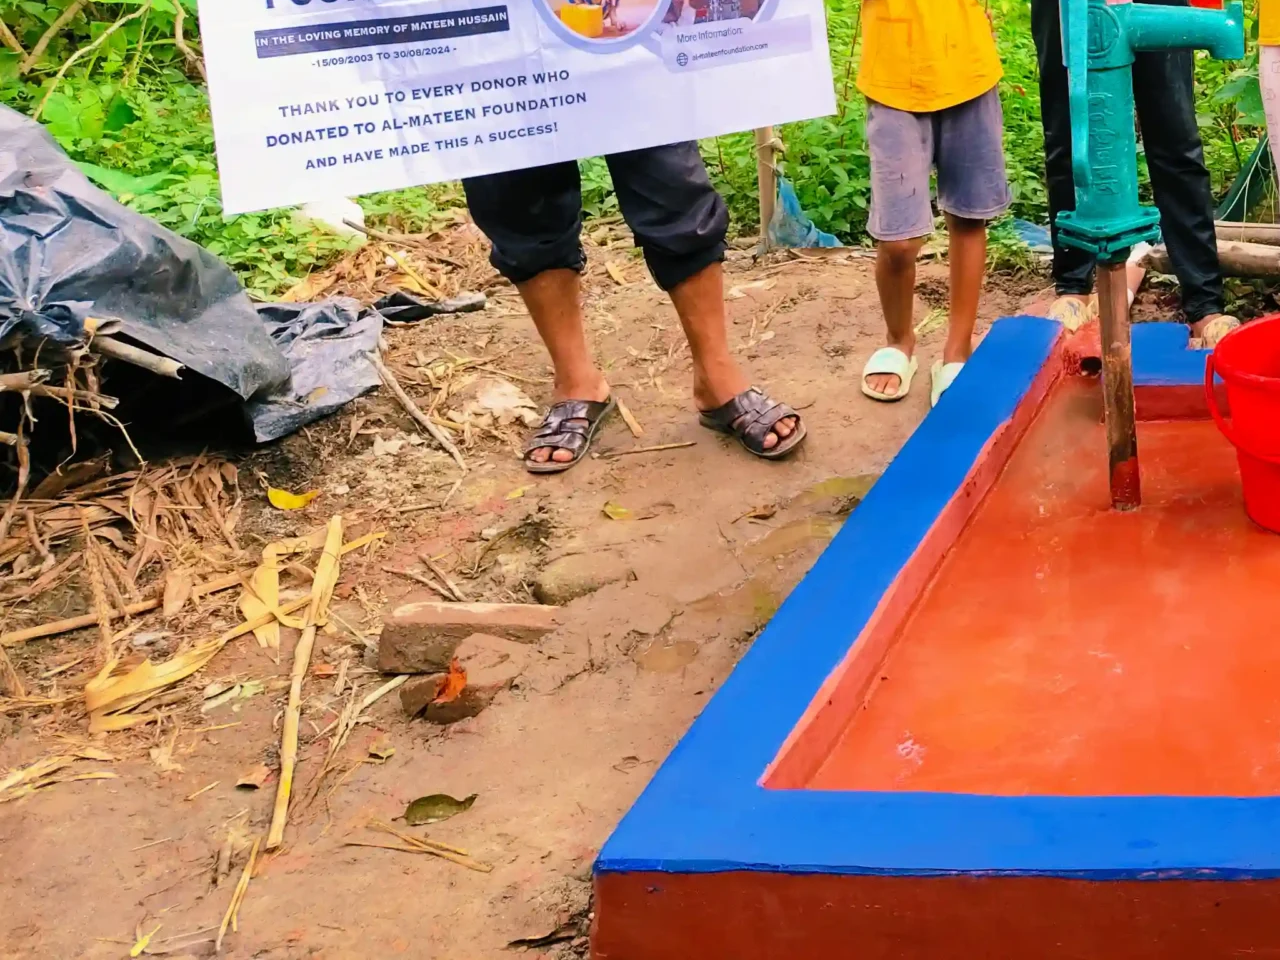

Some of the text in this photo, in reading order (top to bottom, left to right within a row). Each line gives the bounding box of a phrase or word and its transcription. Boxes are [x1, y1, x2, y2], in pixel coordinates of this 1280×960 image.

[255, 11, 507, 47] IN THE LOVING MEMORY OF MATEEN HUSSAIN
[676, 26, 744, 44] More Information:
[311, 52, 374, 68] -15/09/2003
[376, 50, 391, 61] TO
[393, 45, 451, 59] 30/08/2024
[278, 69, 570, 118] THANK YOU TO EVERY DONOR WHO
[266, 92, 587, 148] DONATED TO AL-MATEEN FOUNDATION
[305, 121, 559, 170] AND HAVE MADE THIS A SUCCESS!
